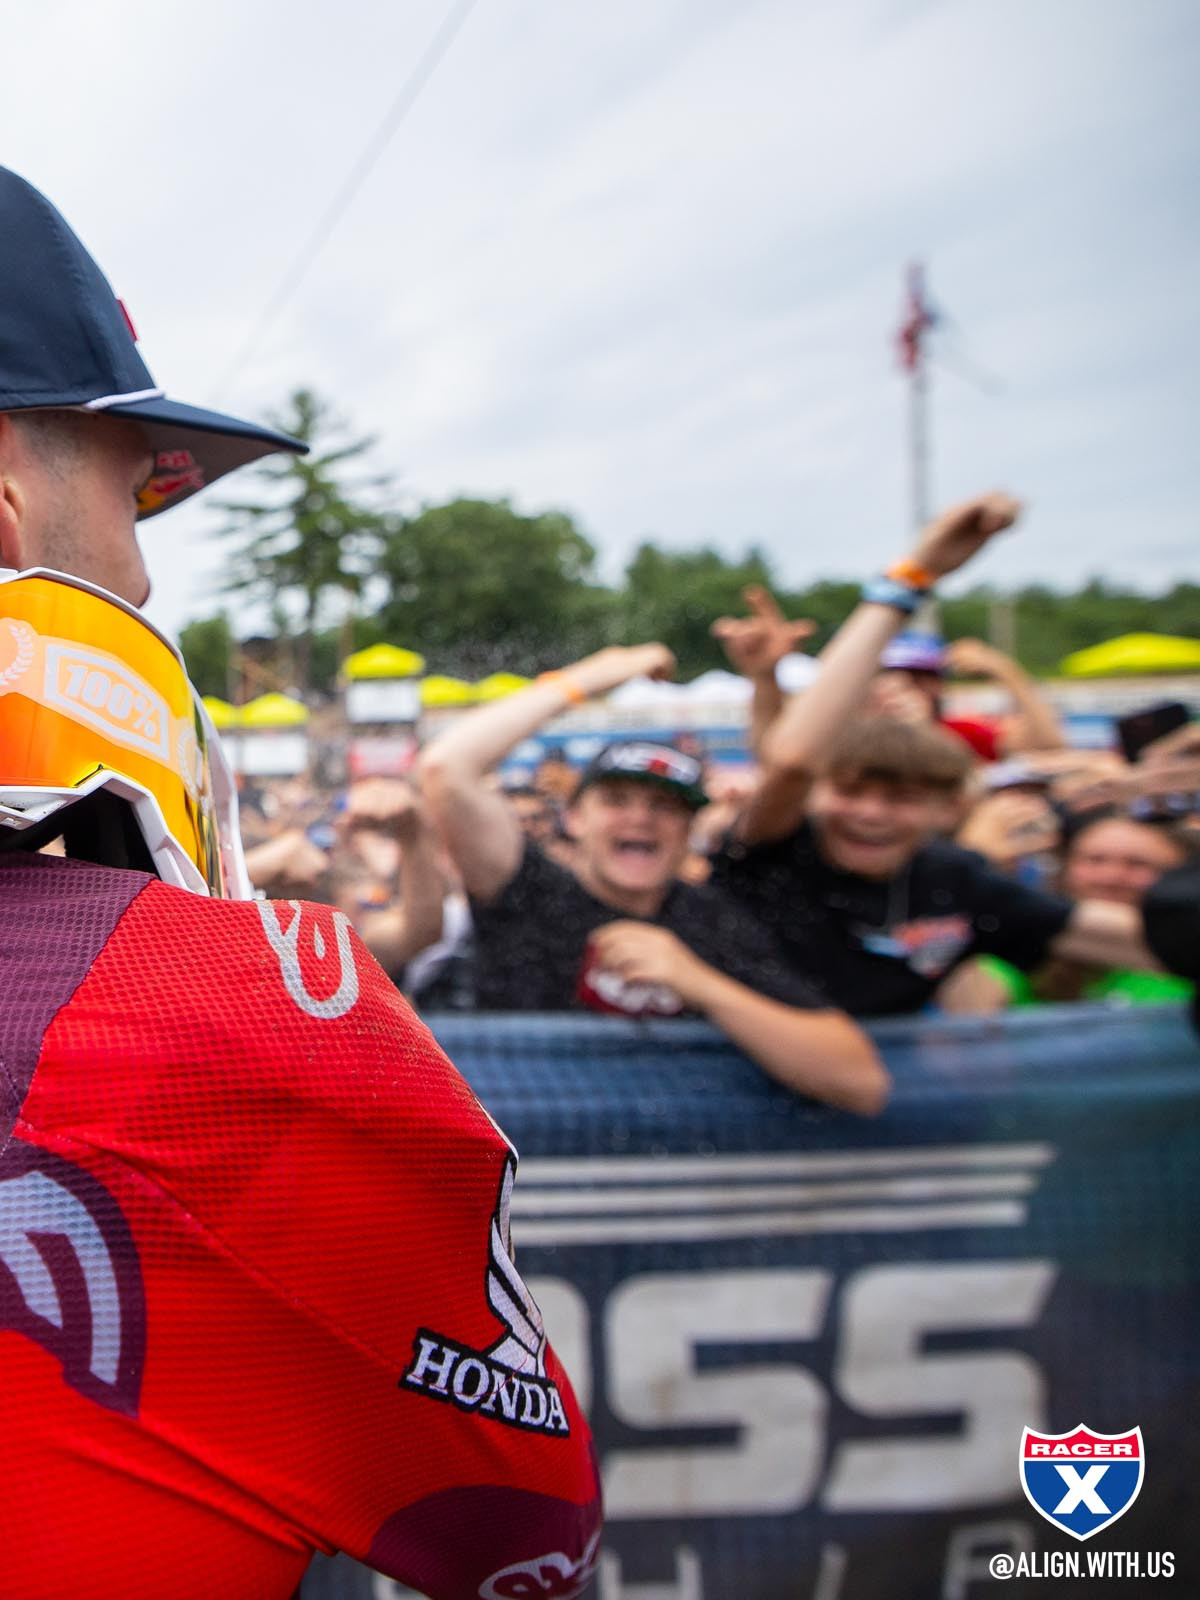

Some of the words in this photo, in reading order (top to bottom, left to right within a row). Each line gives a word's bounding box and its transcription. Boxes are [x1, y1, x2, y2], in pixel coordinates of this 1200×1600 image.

[65, 664, 159, 738] 100%
[405, 1336, 569, 1432] HONDA
[516, 1258, 1058, 1520] SS
